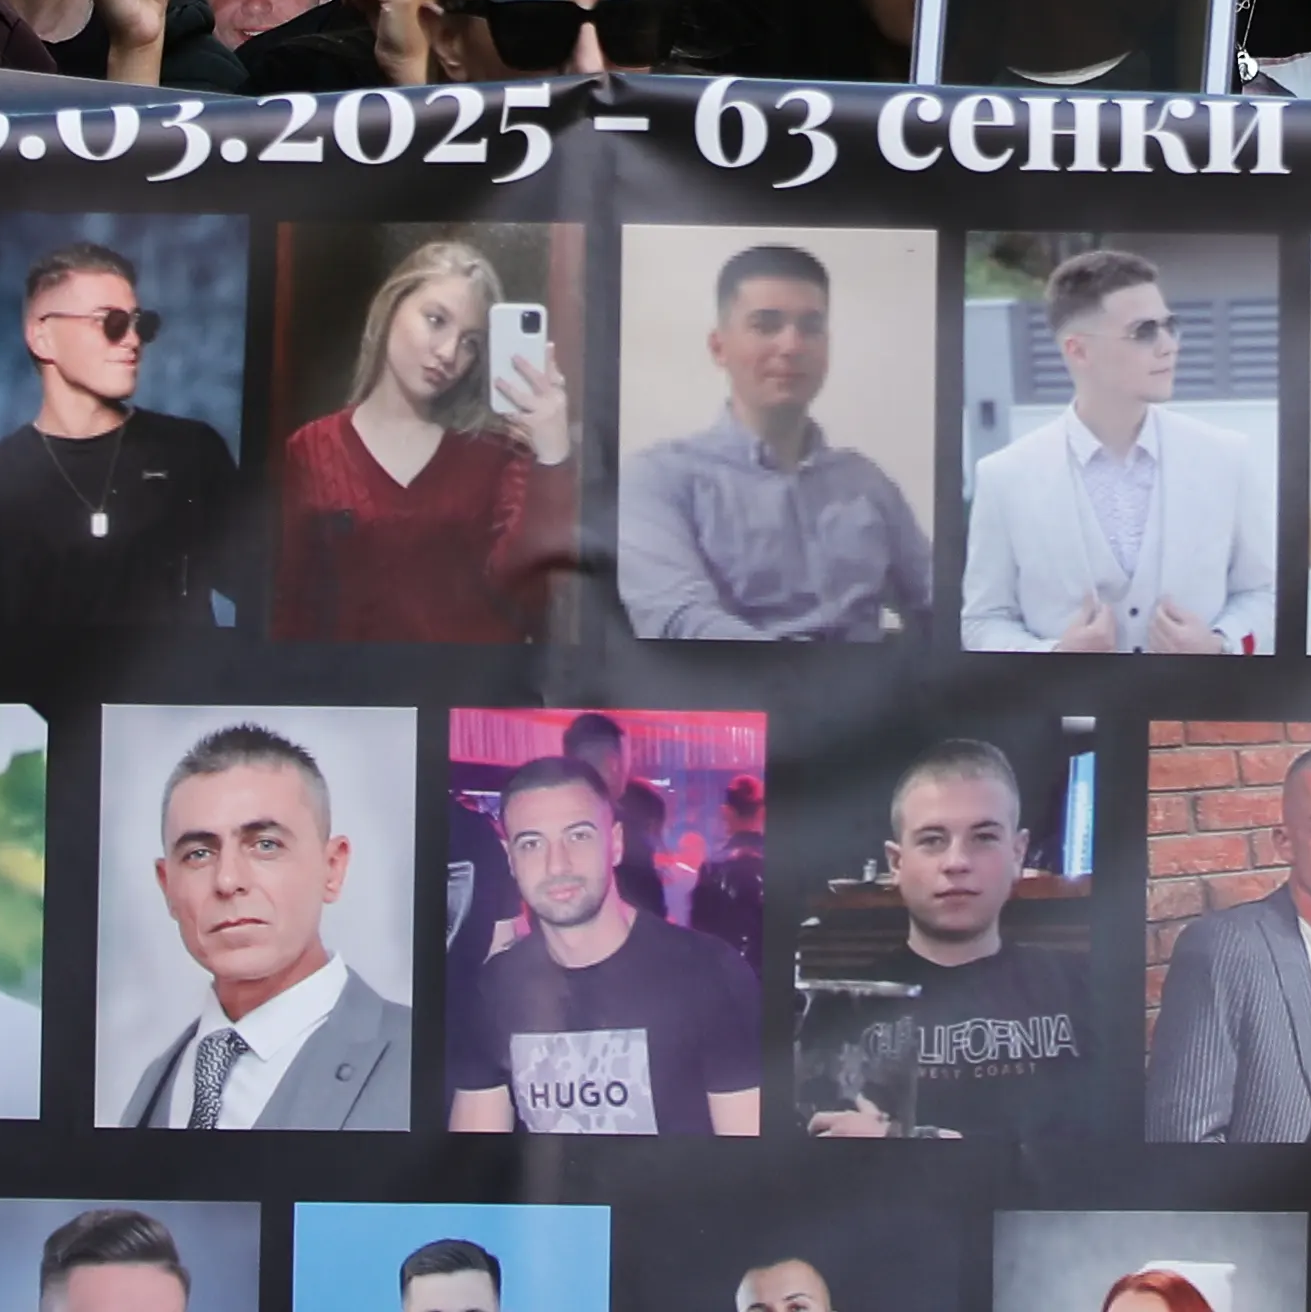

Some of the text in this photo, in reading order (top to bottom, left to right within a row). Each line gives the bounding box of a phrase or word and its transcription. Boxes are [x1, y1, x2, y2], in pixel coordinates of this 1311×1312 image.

[693, 76, 839, 190] 63
[876, 90, 1293, 176] сенки
[529, 1080, 629, 1110] HUGO
